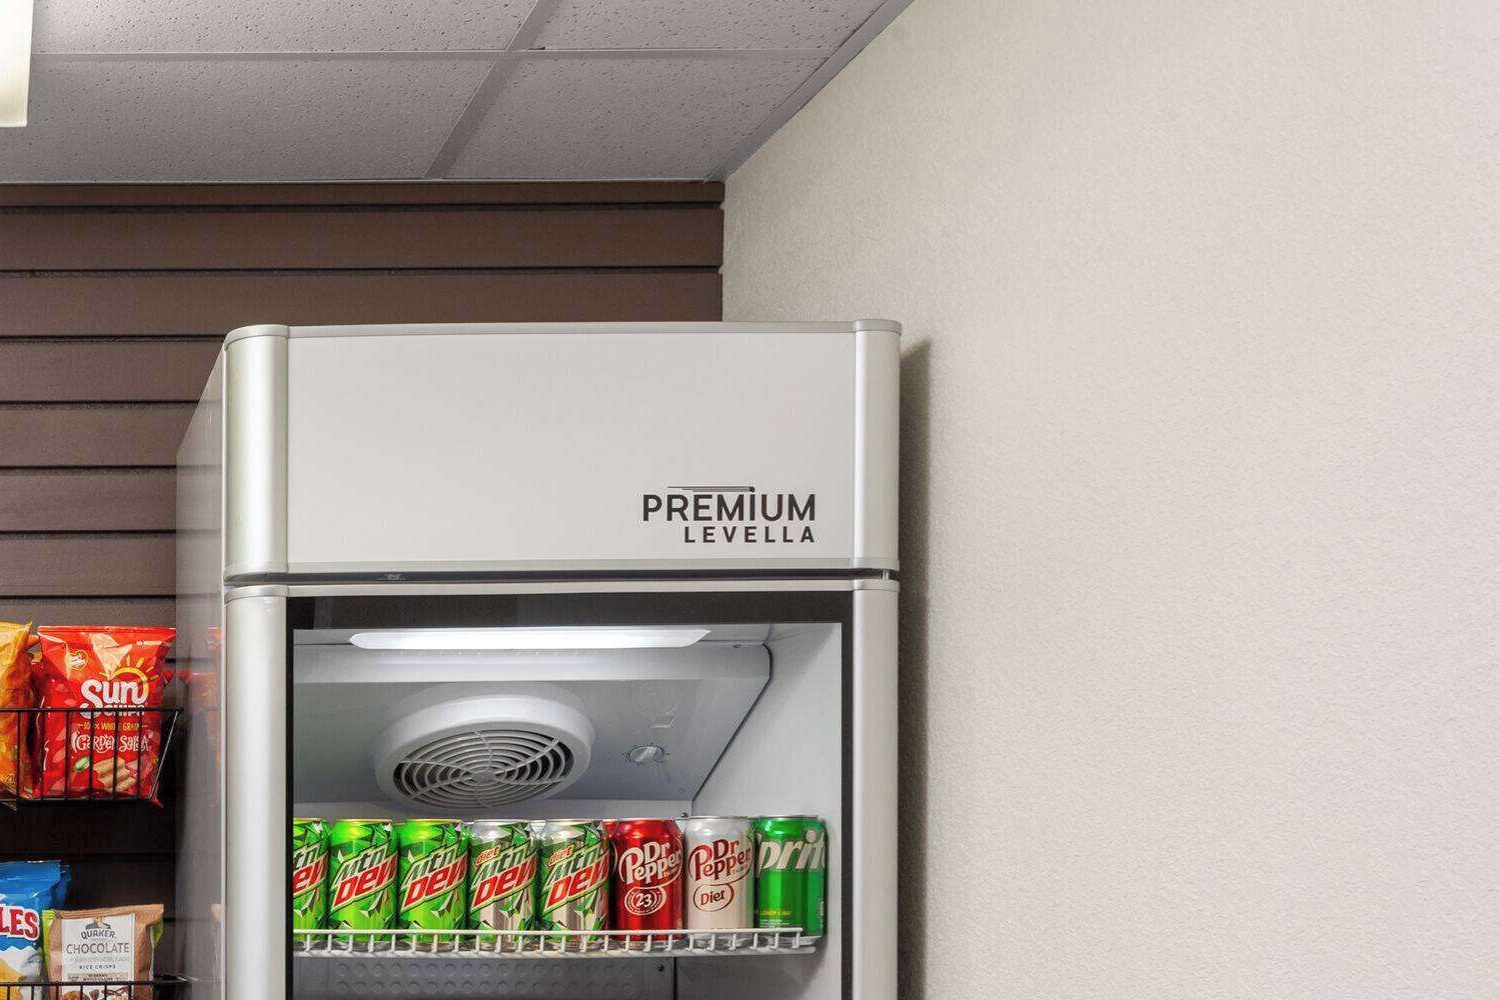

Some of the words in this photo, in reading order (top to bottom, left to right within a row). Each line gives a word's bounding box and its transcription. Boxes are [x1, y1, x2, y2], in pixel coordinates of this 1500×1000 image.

[643, 489, 815, 522] PREMIUM
[684, 526, 815, 543] LEVELLA
[80, 680, 149, 719] Sun
[643, 841, 671, 864] Dr
[712, 838, 740, 860] Dr
[620, 846, 682, 885] Pepper
[689, 844, 750, 882] Pepper
[635, 893, 652, 908] 23
[700, 889, 726, 906] Diet
[80, 930, 116, 939] QUAKER
[66, 942, 130, 954] CHOCOLATE
